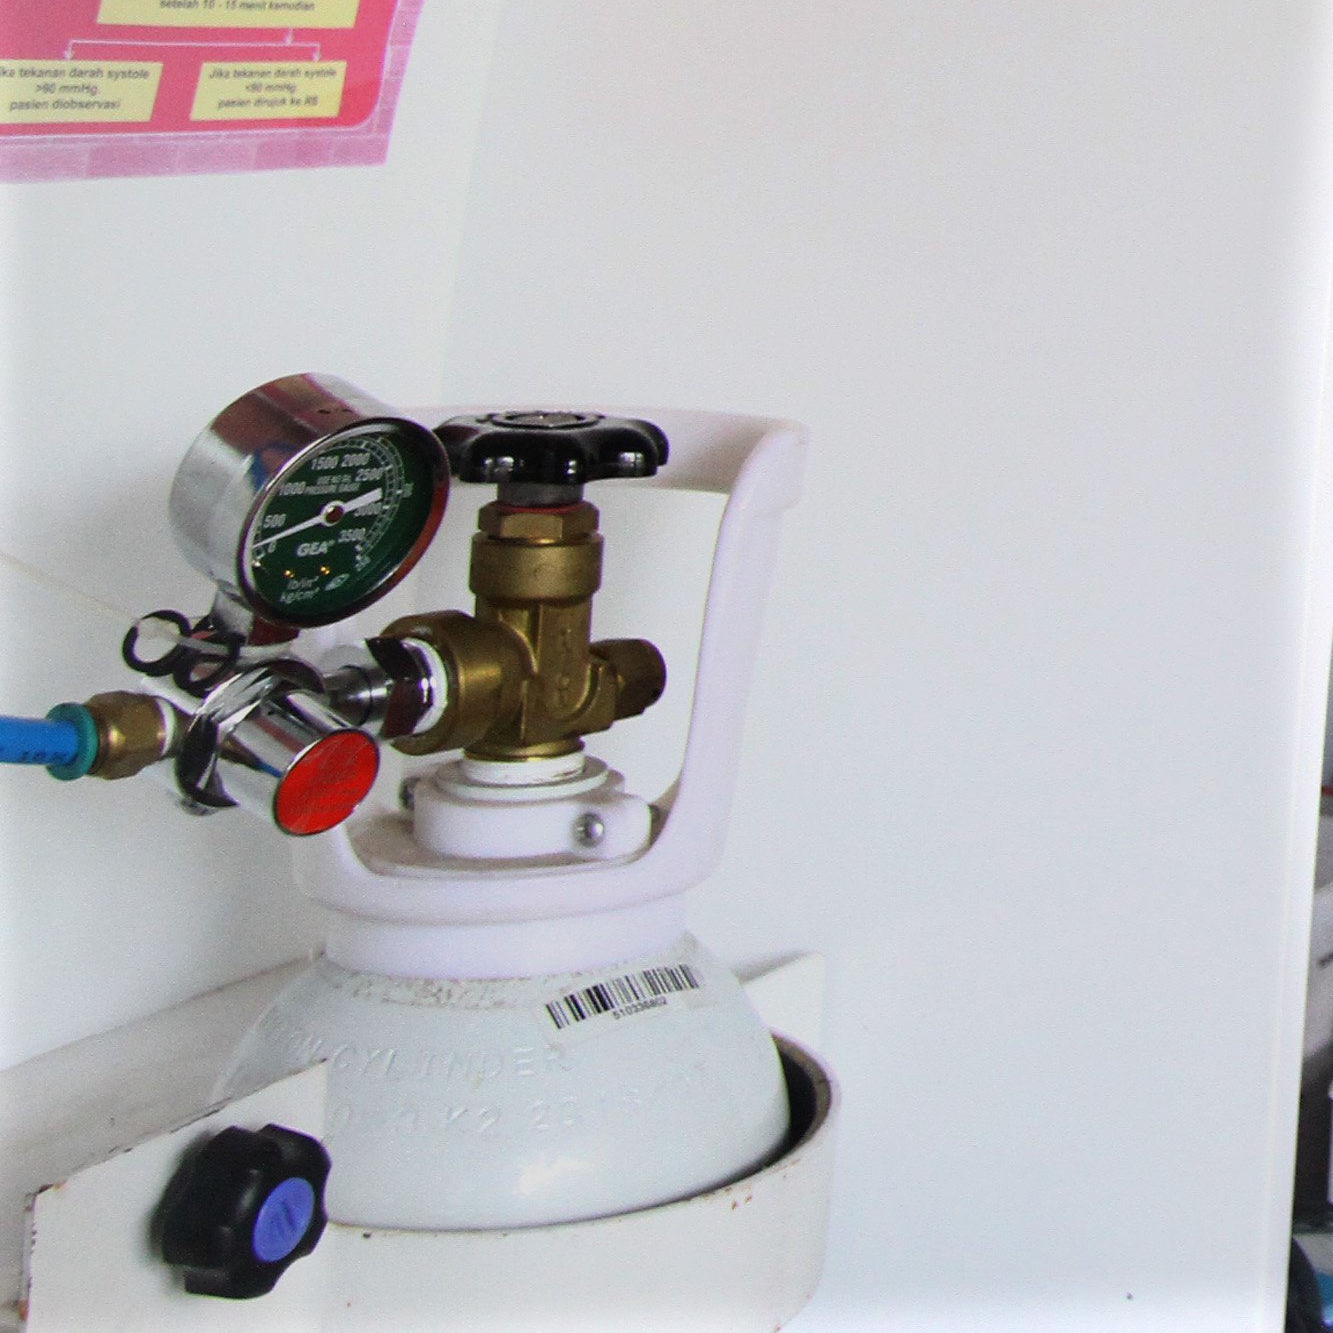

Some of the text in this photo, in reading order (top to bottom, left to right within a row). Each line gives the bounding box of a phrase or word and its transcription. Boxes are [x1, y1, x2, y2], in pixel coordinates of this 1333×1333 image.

[19, 67, 66, 79] tekanan
[69, 67, 104, 79] darah
[107, 68, 150, 81] systole
[10, 98, 121, 112] pasien diobservasi
[311, 453, 371, 470] 1500 2000
[355, 467, 385, 482] 2500
[279, 481, 306, 496] 1000
[263, 513, 287, 529] 500
[337, 528, 367, 544] 3500
